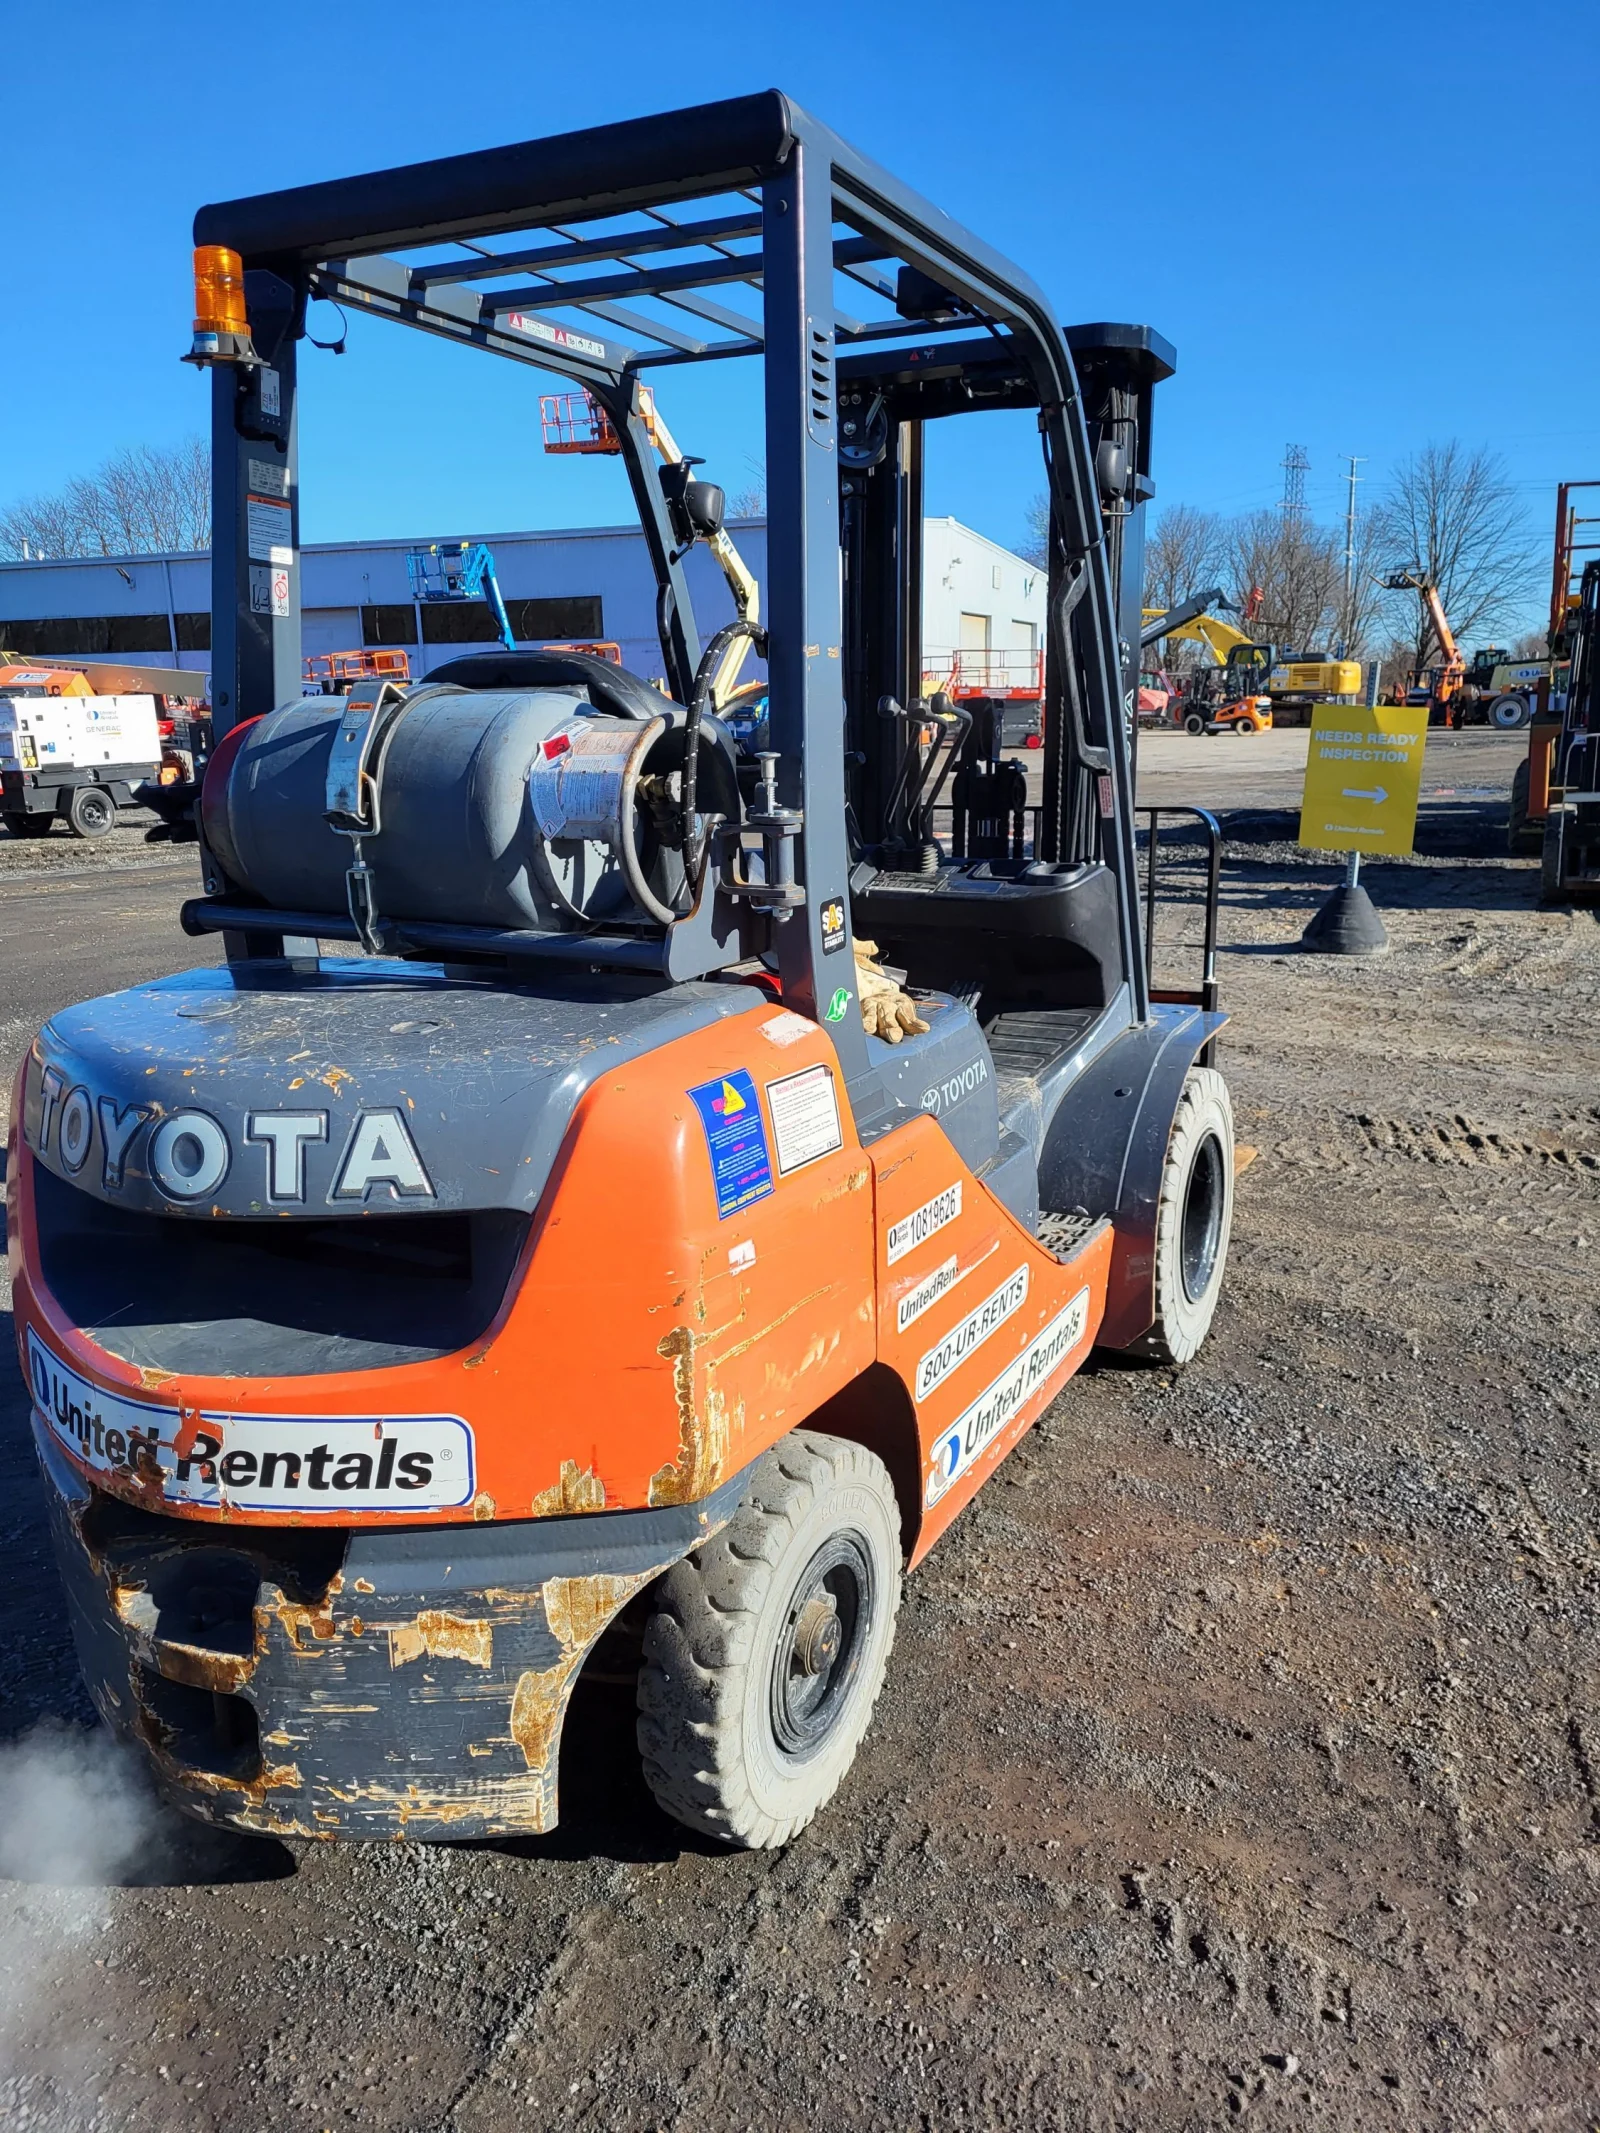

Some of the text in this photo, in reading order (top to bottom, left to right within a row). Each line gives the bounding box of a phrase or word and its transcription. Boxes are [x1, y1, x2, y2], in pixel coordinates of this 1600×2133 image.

[86, 725, 122, 734] GENERAC
[1315, 730, 1419, 746] NEEDS READY
[1320, 748, 1409, 763] INSPECTION
[822, 904, 844, 934] SAS
[941, 1058, 988, 1107] TOYOTA
[38, 1064, 438, 1206] TOYOTA
[910, 1187, 956, 1245] 10819626
[923, 1276, 1024, 1388] 800-UR-RENTS
[965, 1309, 1081, 1455] United Rentals
[53, 1374, 433, 1491] United Rentals
